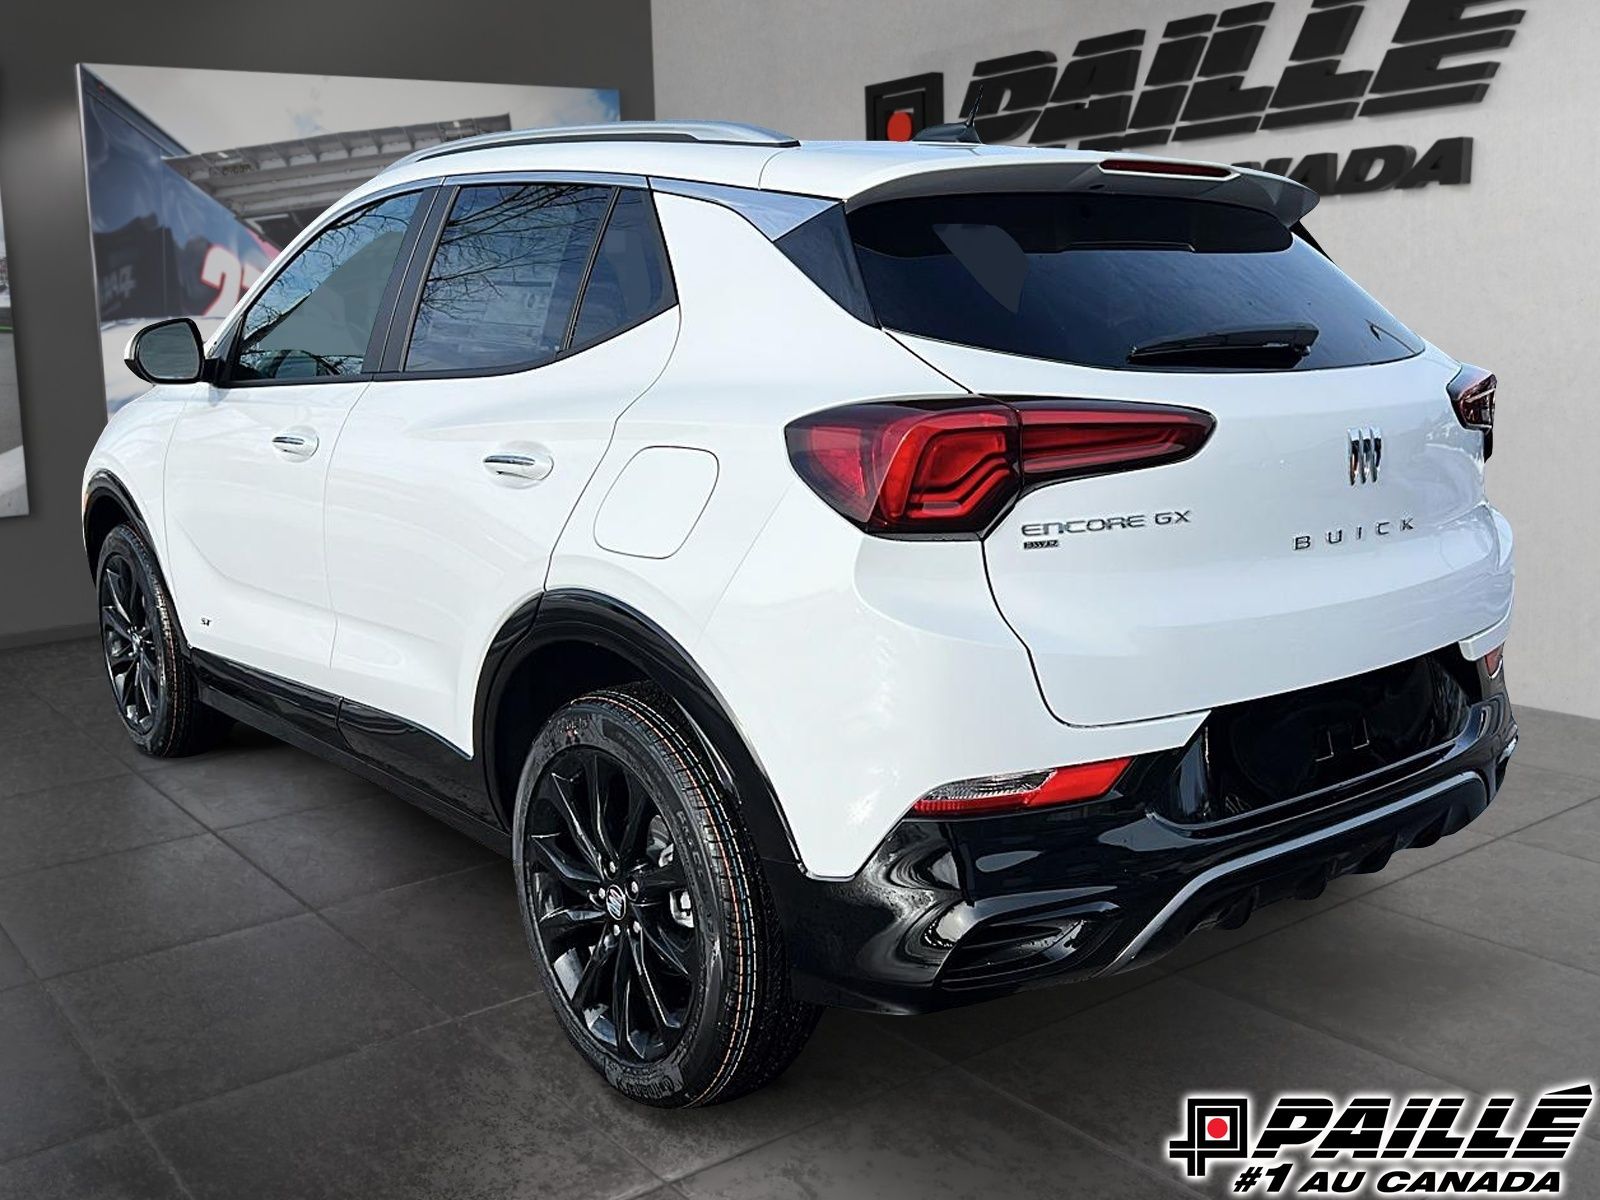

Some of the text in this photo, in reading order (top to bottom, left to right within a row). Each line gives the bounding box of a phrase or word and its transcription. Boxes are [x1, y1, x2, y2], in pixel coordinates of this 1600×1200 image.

[1233, 137, 1474, 198] ADA
[1021, 510, 1191, 537] ENCORE GX
[1293, 517, 1414, 551] BUICK
